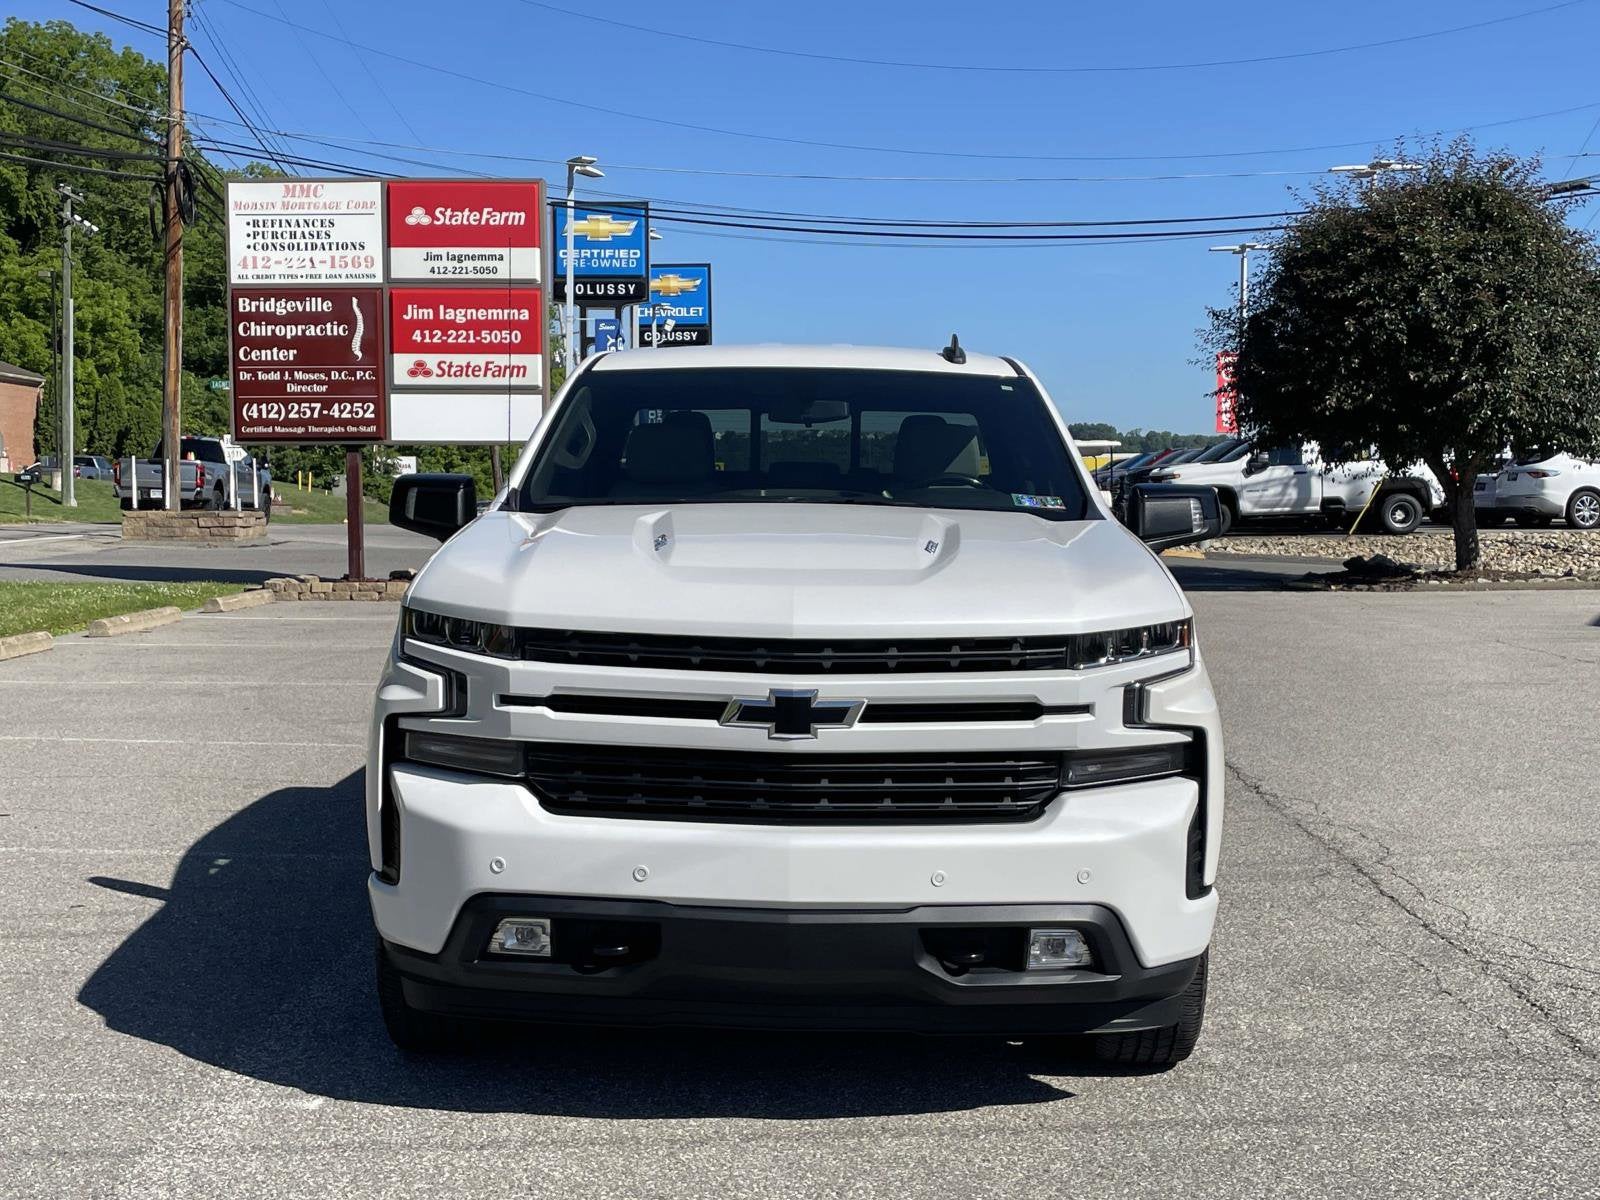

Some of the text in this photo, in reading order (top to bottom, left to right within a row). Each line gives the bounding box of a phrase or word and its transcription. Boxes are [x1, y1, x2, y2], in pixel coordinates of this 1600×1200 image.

[282, 184, 325, 198] MMC
[281, 200, 342, 211] MORTGAGE
[252, 219, 335, 228] REFINANCES
[252, 230, 331, 240] PURCHASES
[253, 242, 366, 252] CONSOLIDATIONS
[423, 252, 504, 263] Jim Iagnemma
[559, 249, 641, 259] CERTIFIED
[429, 266, 498, 275] 412-221-5050
[238, 297, 333, 315] Bridgeville
[637, 306, 705, 317] CHEVROLET
[403, 304, 530, 323] Jim Iagnemma
[238, 321, 349, 339] Chiropractic
[412, 329, 522, 343] 412-221-5050
[239, 346, 298, 361] Center
[239, 371, 255, 380] Dr.
[257, 371, 281, 380] Todd
[283, 371, 292, 380] J.
[294, 371, 329, 382] Moses,
[356, 371, 376, 380] P.C.
[286, 383, 328, 392] Director
[241, 425, 377, 434] Certified Massage Therapists On-Staff
